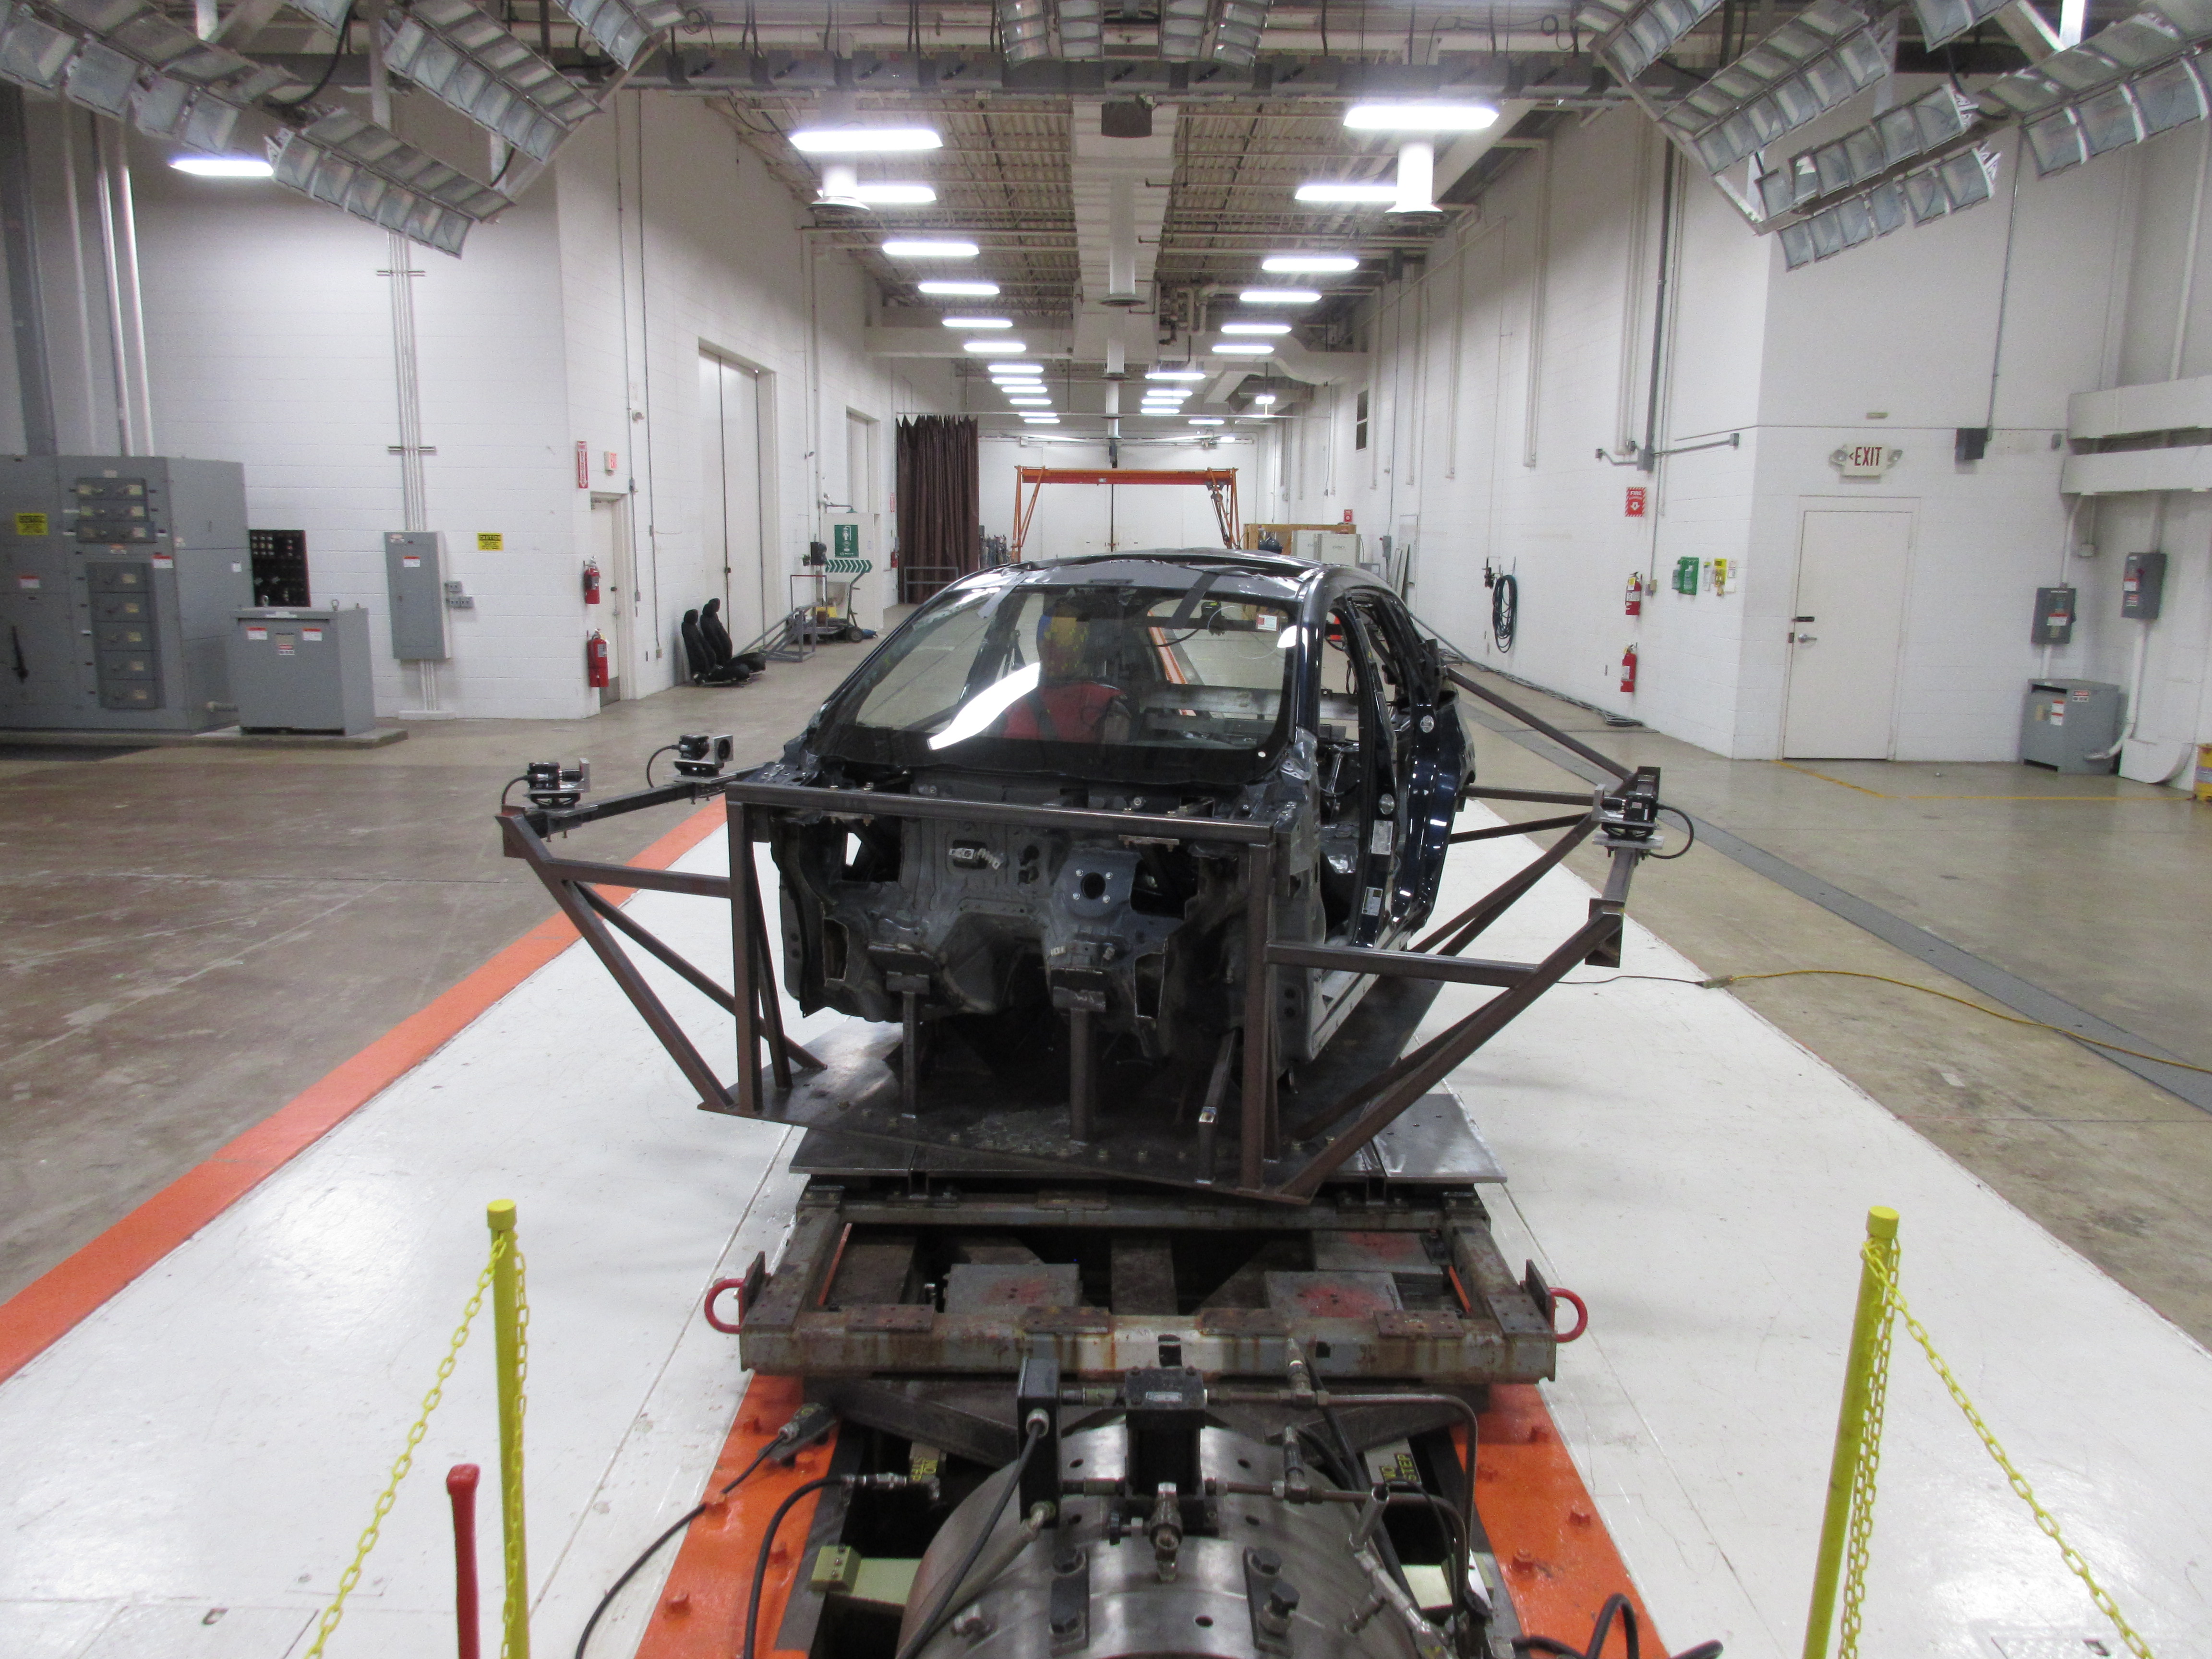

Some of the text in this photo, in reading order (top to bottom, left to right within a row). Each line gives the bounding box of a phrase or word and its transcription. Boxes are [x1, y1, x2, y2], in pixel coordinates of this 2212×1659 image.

[1854, 447, 1882, 466] EXIT
[911, 1456, 925, 1481] STEP
[924, 1460, 938, 1475] NO
[1382, 1466, 1396, 1480] NO
[1397, 1454, 1416, 1481] STEP
